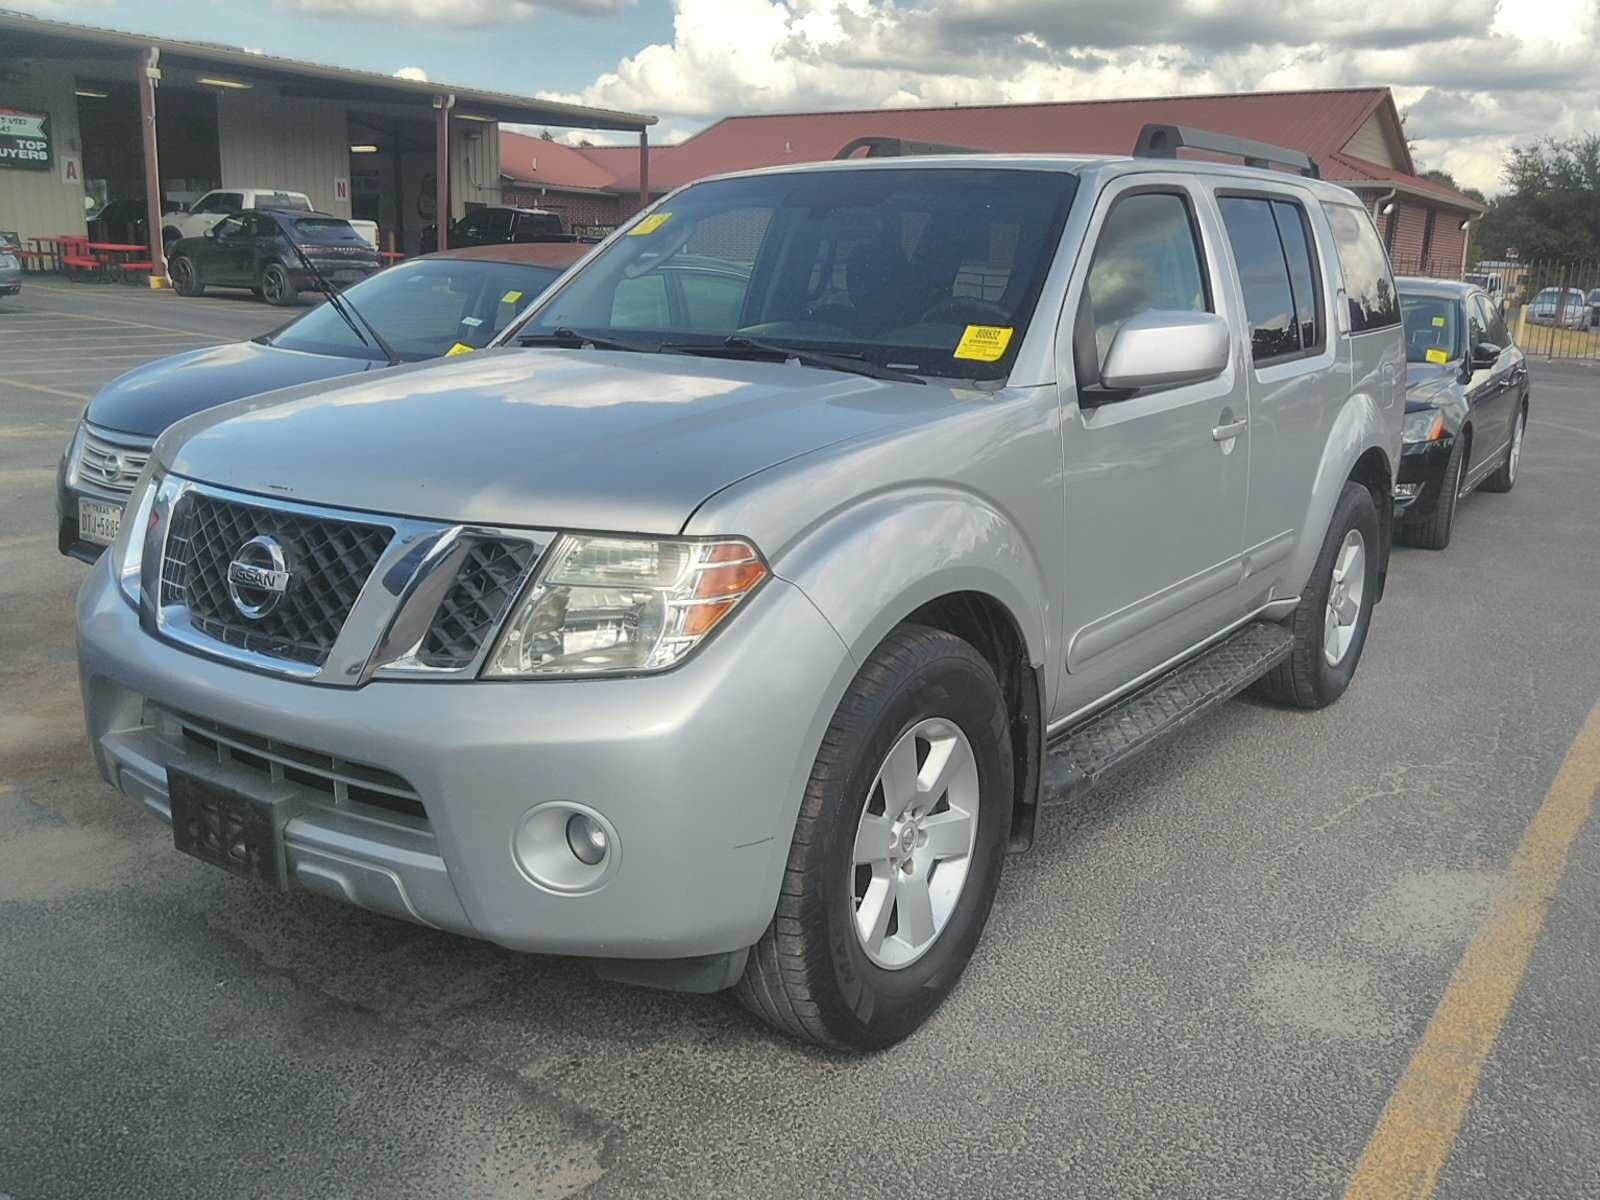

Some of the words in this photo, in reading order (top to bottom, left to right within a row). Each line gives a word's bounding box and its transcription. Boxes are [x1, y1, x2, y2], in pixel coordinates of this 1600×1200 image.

[16, 139, 48, 151] TOP
[0, 147, 49, 161] UYERS
[66, 160, 78, 180] A
[337, 181, 347, 198] N
